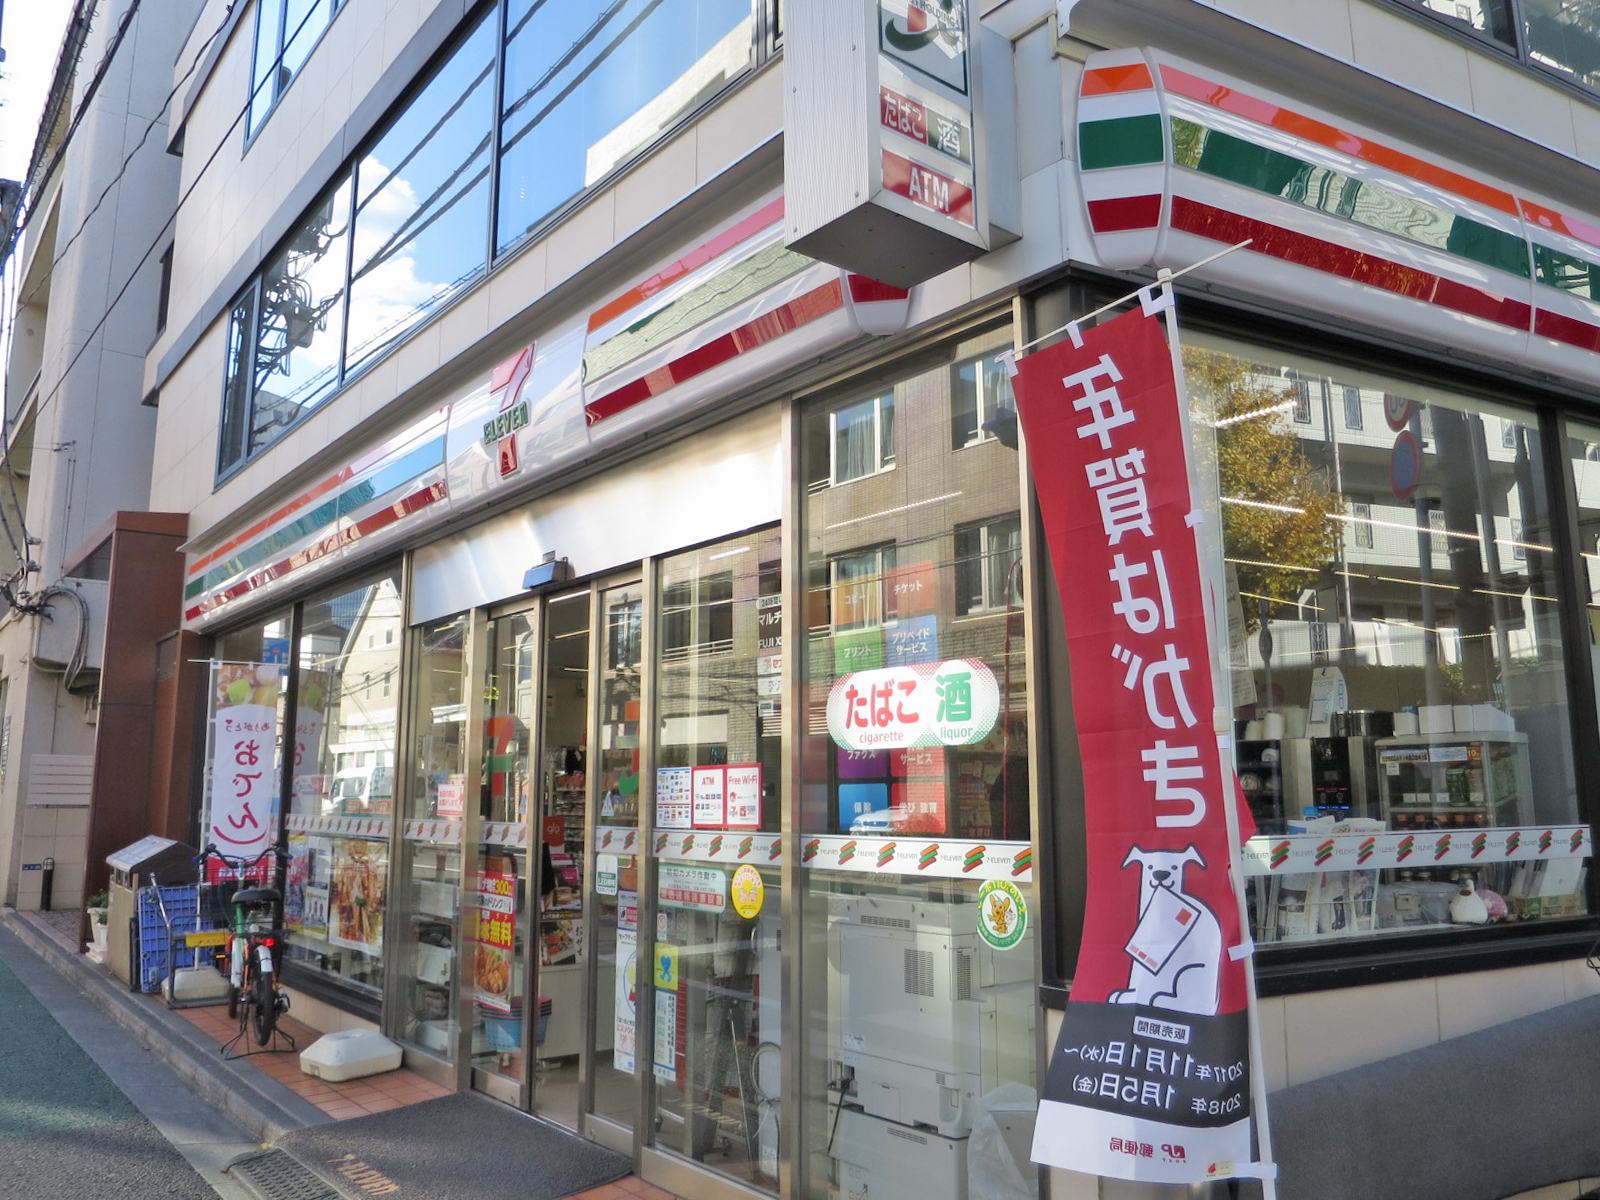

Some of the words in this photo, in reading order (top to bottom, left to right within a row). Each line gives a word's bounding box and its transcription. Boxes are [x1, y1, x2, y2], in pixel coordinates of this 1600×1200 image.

[884, 92, 924, 139] たばこ
[937, 116, 961, 157] 酒
[908, 167, 950, 212] ATM
[893, 579, 923, 596] チケット
[845, 593, 866, 605] コピー
[892, 628, 930, 645] プリペイド
[843, 645, 871, 659] プリント
[895, 642, 928, 656] サービス
[845, 678, 919, 729] たばこ
[935, 672, 972, 723] 酒
[859, 730, 904, 745] cigarette
[940, 726, 974, 741] liquor
[900, 752, 933, 765] サービス
[702, 776, 715, 786] ATM
[729, 775, 741, 785] Free
[742, 774, 758, 785] Wi-Fi
[853, 801, 872, 814] 保険
[920, 801, 937, 814] 教育
[666, 867, 717, 880] 防犯カメラ作動中
